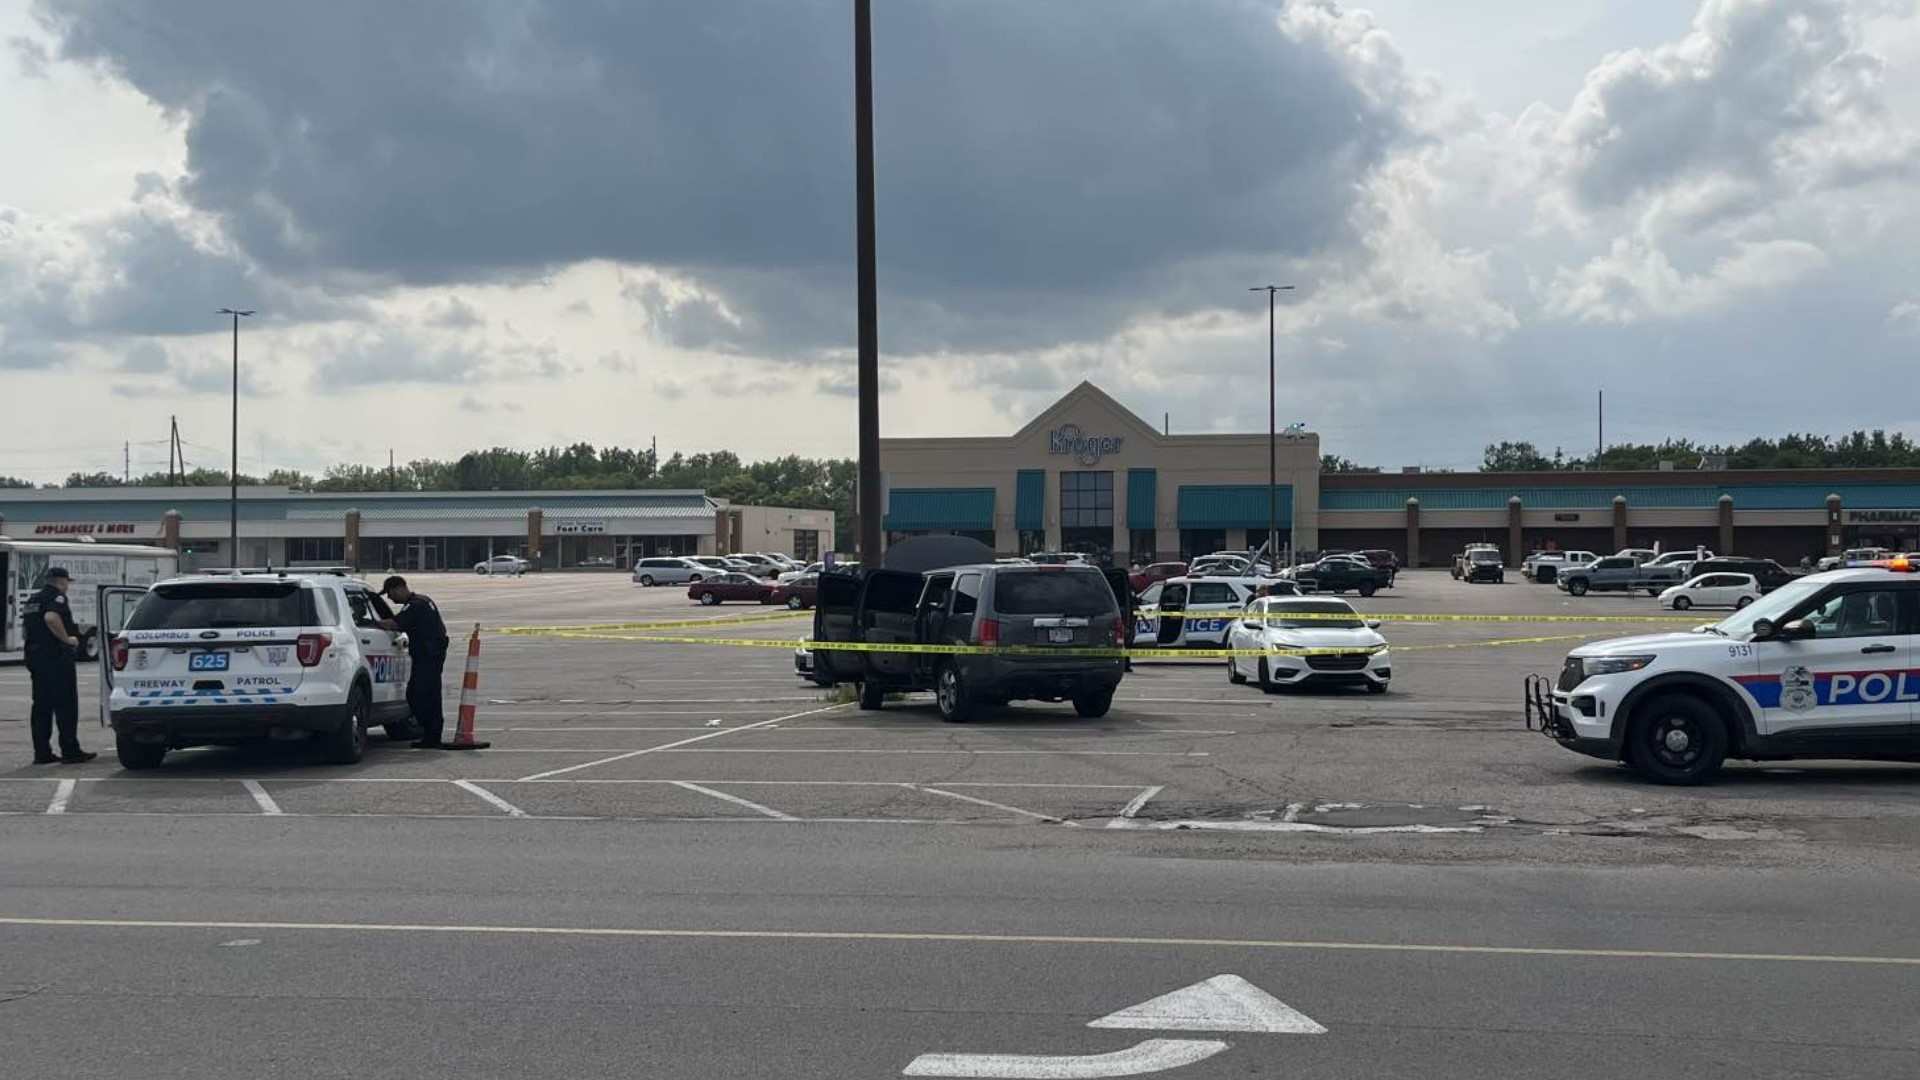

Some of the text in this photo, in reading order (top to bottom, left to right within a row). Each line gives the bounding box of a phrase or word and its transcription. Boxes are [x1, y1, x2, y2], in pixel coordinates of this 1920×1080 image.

[1049, 423, 1124, 466] Kroger
[35, 524, 95, 534] APPLIANCES
[106, 524, 136, 533] MORE
[135, 631, 190, 640] COLUMBUS
[236, 630, 276, 638] POLICE
[1728, 644, 1753, 657] 9131
[192, 654, 227, 668] 625
[134, 679, 186, 688] FREEWAY
[236, 677, 281, 685] PATROL
